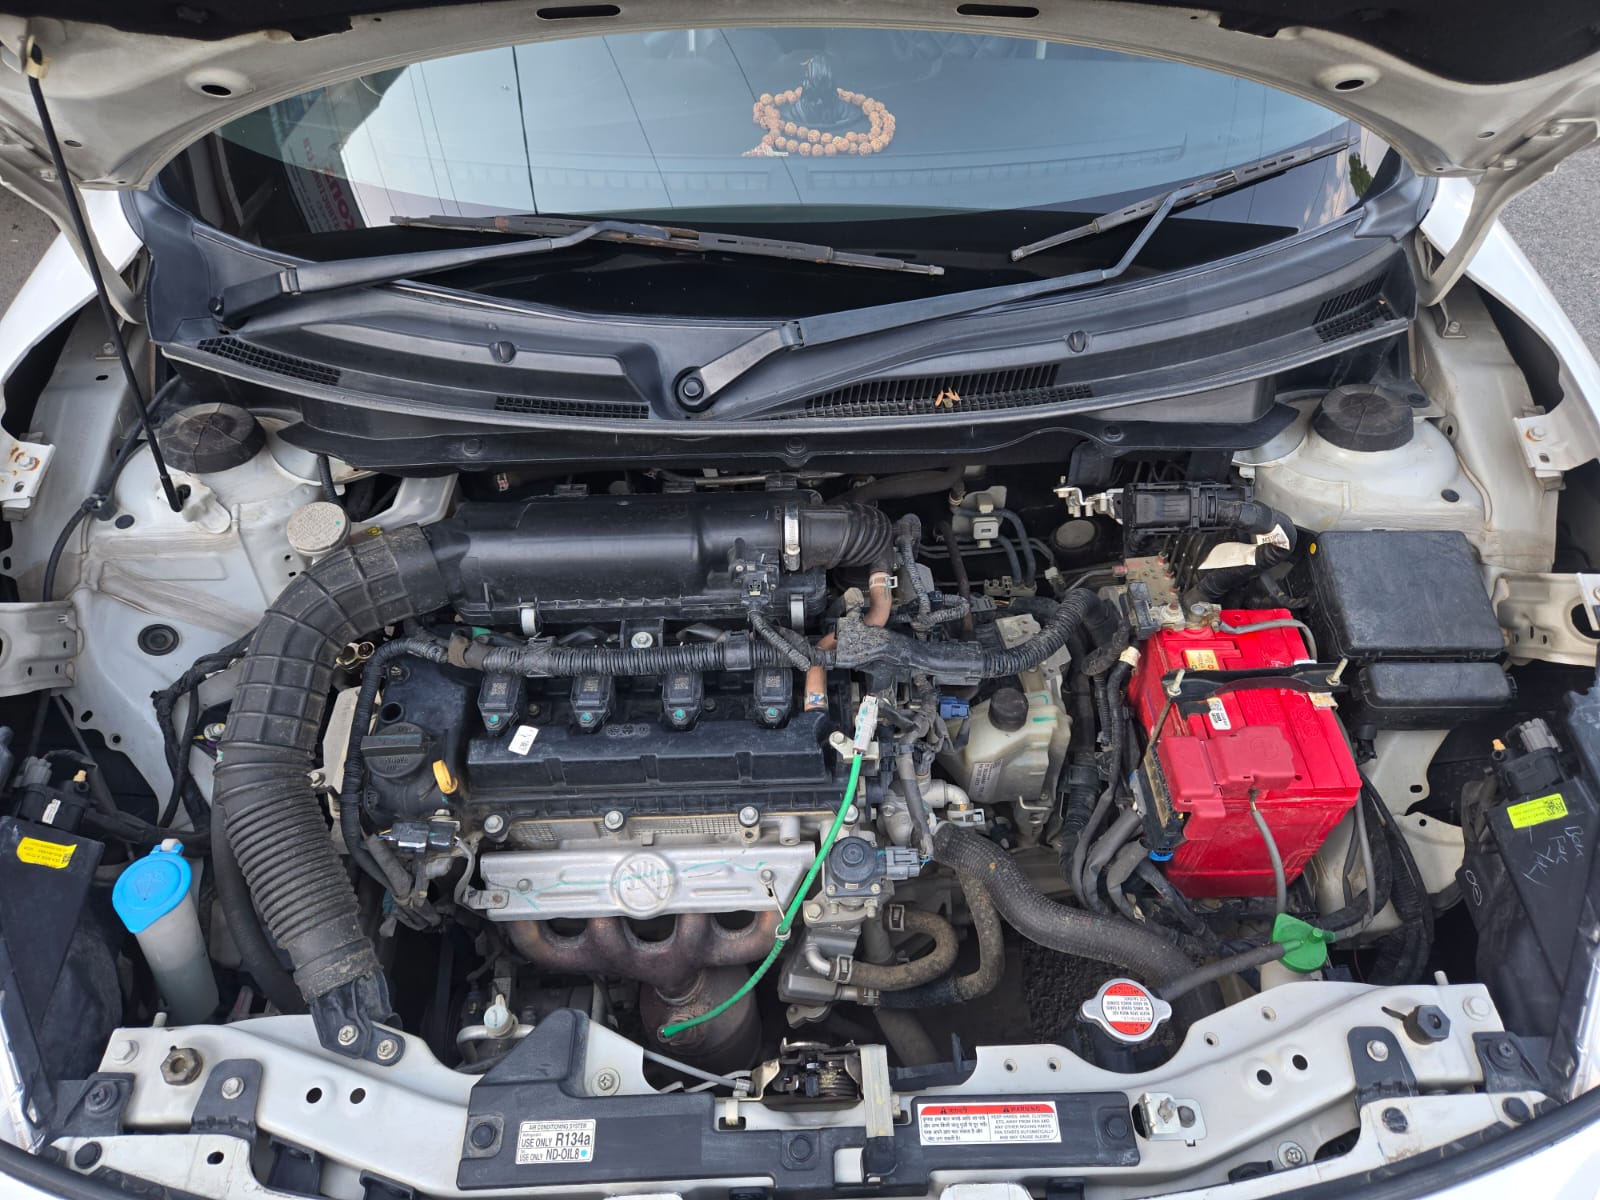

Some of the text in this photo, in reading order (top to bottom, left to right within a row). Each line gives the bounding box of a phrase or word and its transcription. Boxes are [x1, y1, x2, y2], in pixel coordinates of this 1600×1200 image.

[521, 1132, 590, 1148] USE ONLY R134a
[520, 1148, 580, 1161] USE ONLY ND-OIL8
